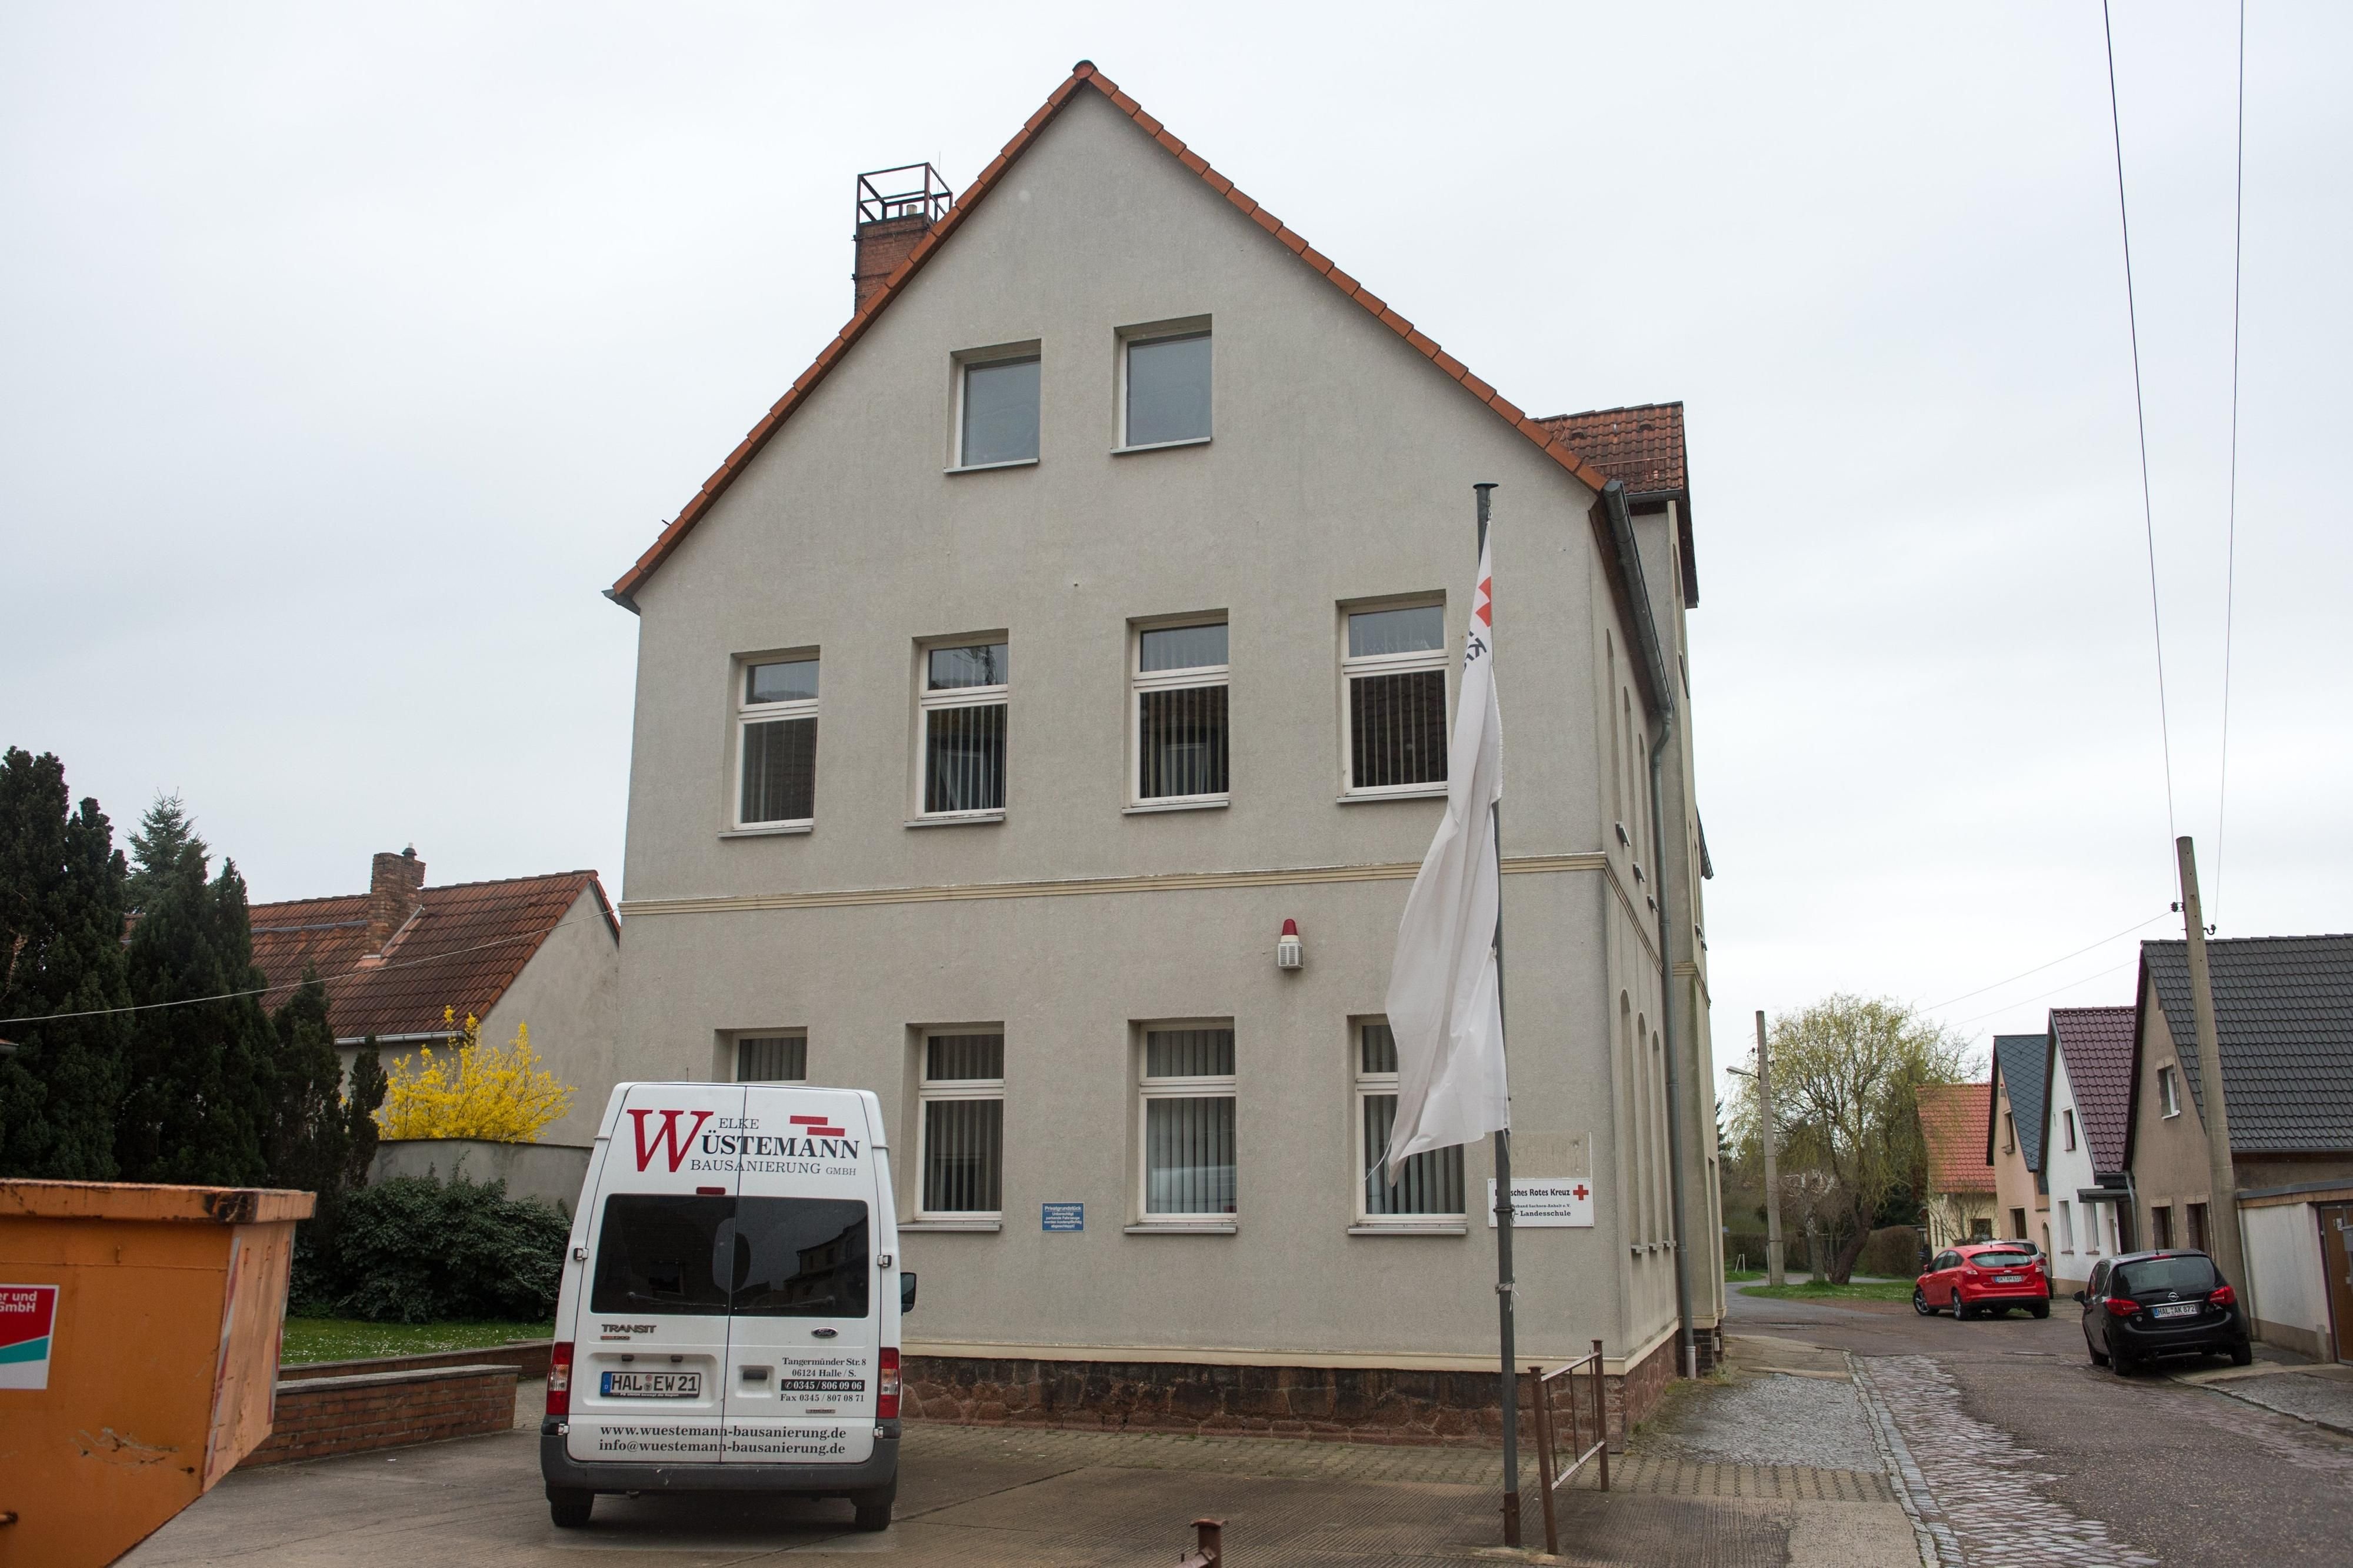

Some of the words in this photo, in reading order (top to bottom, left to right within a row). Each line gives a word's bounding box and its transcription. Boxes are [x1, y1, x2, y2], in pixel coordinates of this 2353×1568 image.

[719, 1118, 759, 1129] ELKE
[690, 1159, 821, 1174] BAUSANIERUNG
[826, 1167, 856, 1176] GMBH
[1529, 1188, 1548, 1196] Rotes
[12, 1290, 38, 1302] und
[601, 1324, 656, 1333] TRANSIT
[782, 1357, 845, 1367] Tangermünder
[792, 1369, 816, 1377] 06124
[818, 1369, 842, 1377] Halle
[611, 1375, 642, 1391] HAL
[654, 1376, 675, 1391] EW
[678, 1376, 697, 1392] 21
[794, 1381, 815, 1390] 0345
[821, 1381, 838, 1390] 806
[839, 1382, 849, 1390] 09
[851, 1382, 862, 1390] 06
[780, 1393, 796, 1402] Fax
[799, 1394, 819, 1402] 0345
[826, 1394, 841, 1402] 807
[600, 1425, 846, 1441] www.wuestemann-bausanierung.de
[598, 1439, 845, 1456] info@wuestemann-bausanierung.de
